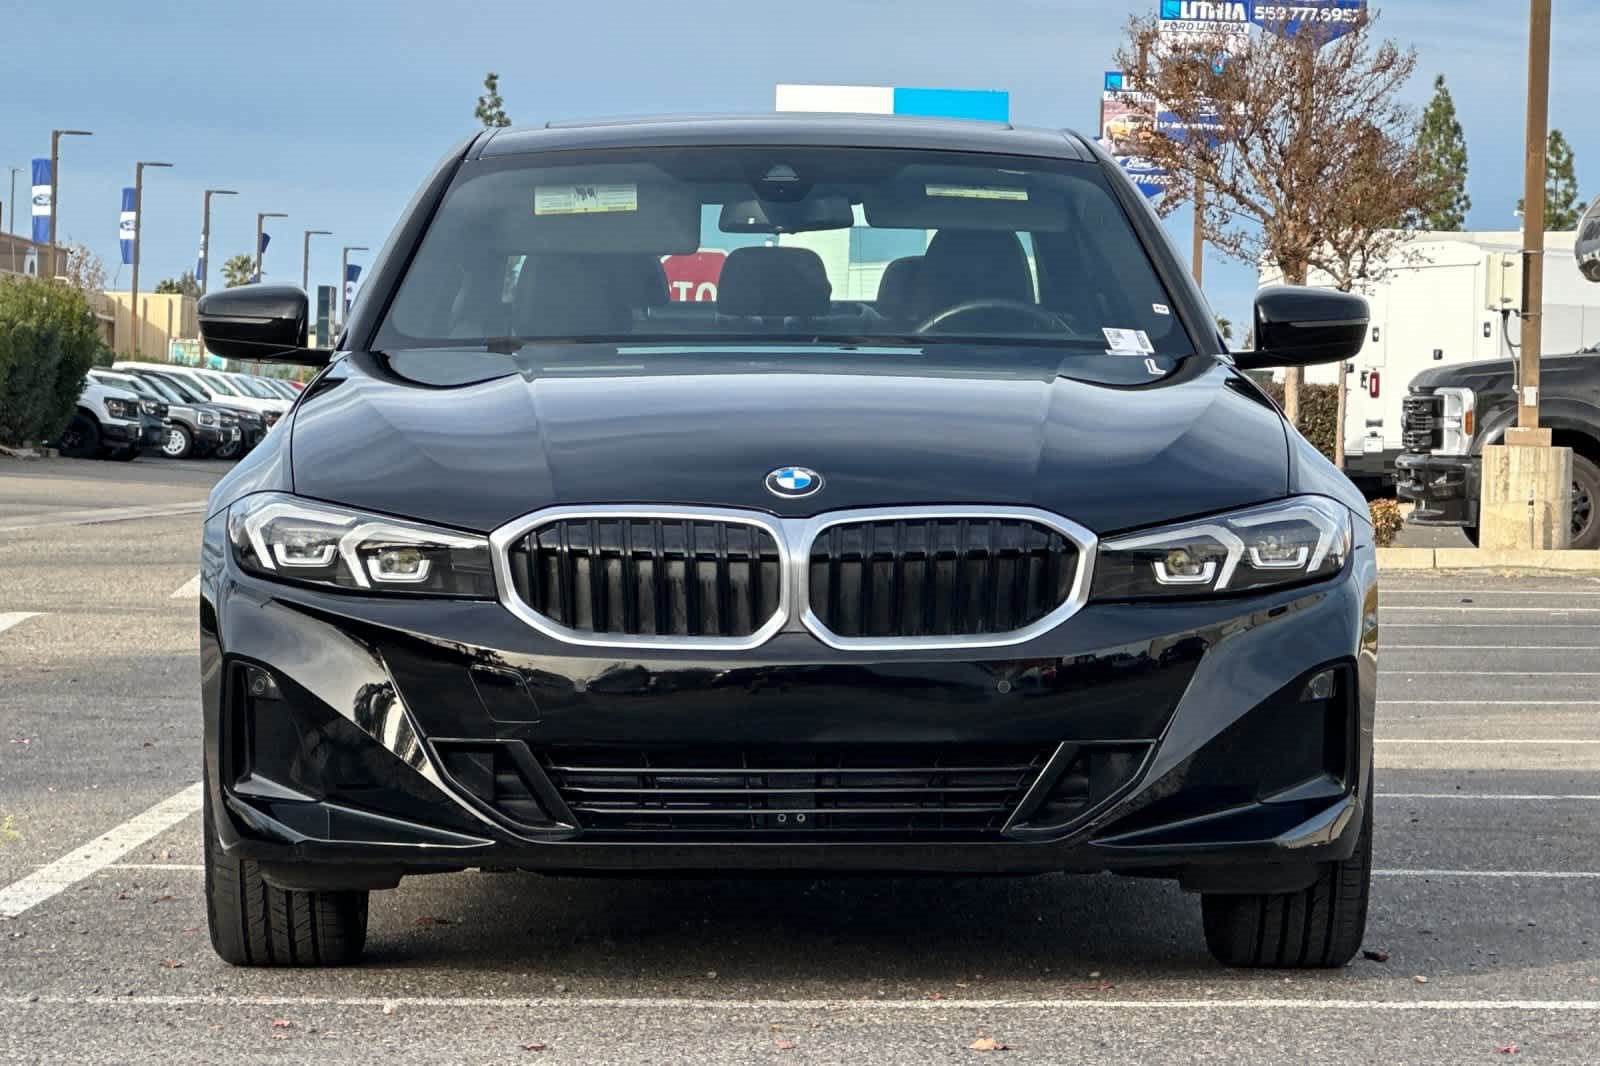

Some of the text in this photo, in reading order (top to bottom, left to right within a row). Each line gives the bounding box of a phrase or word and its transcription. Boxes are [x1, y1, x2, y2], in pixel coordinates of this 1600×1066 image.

[1163, 22, 1245, 33] FORD LINCOLN
[671, 281, 718, 302] TO
